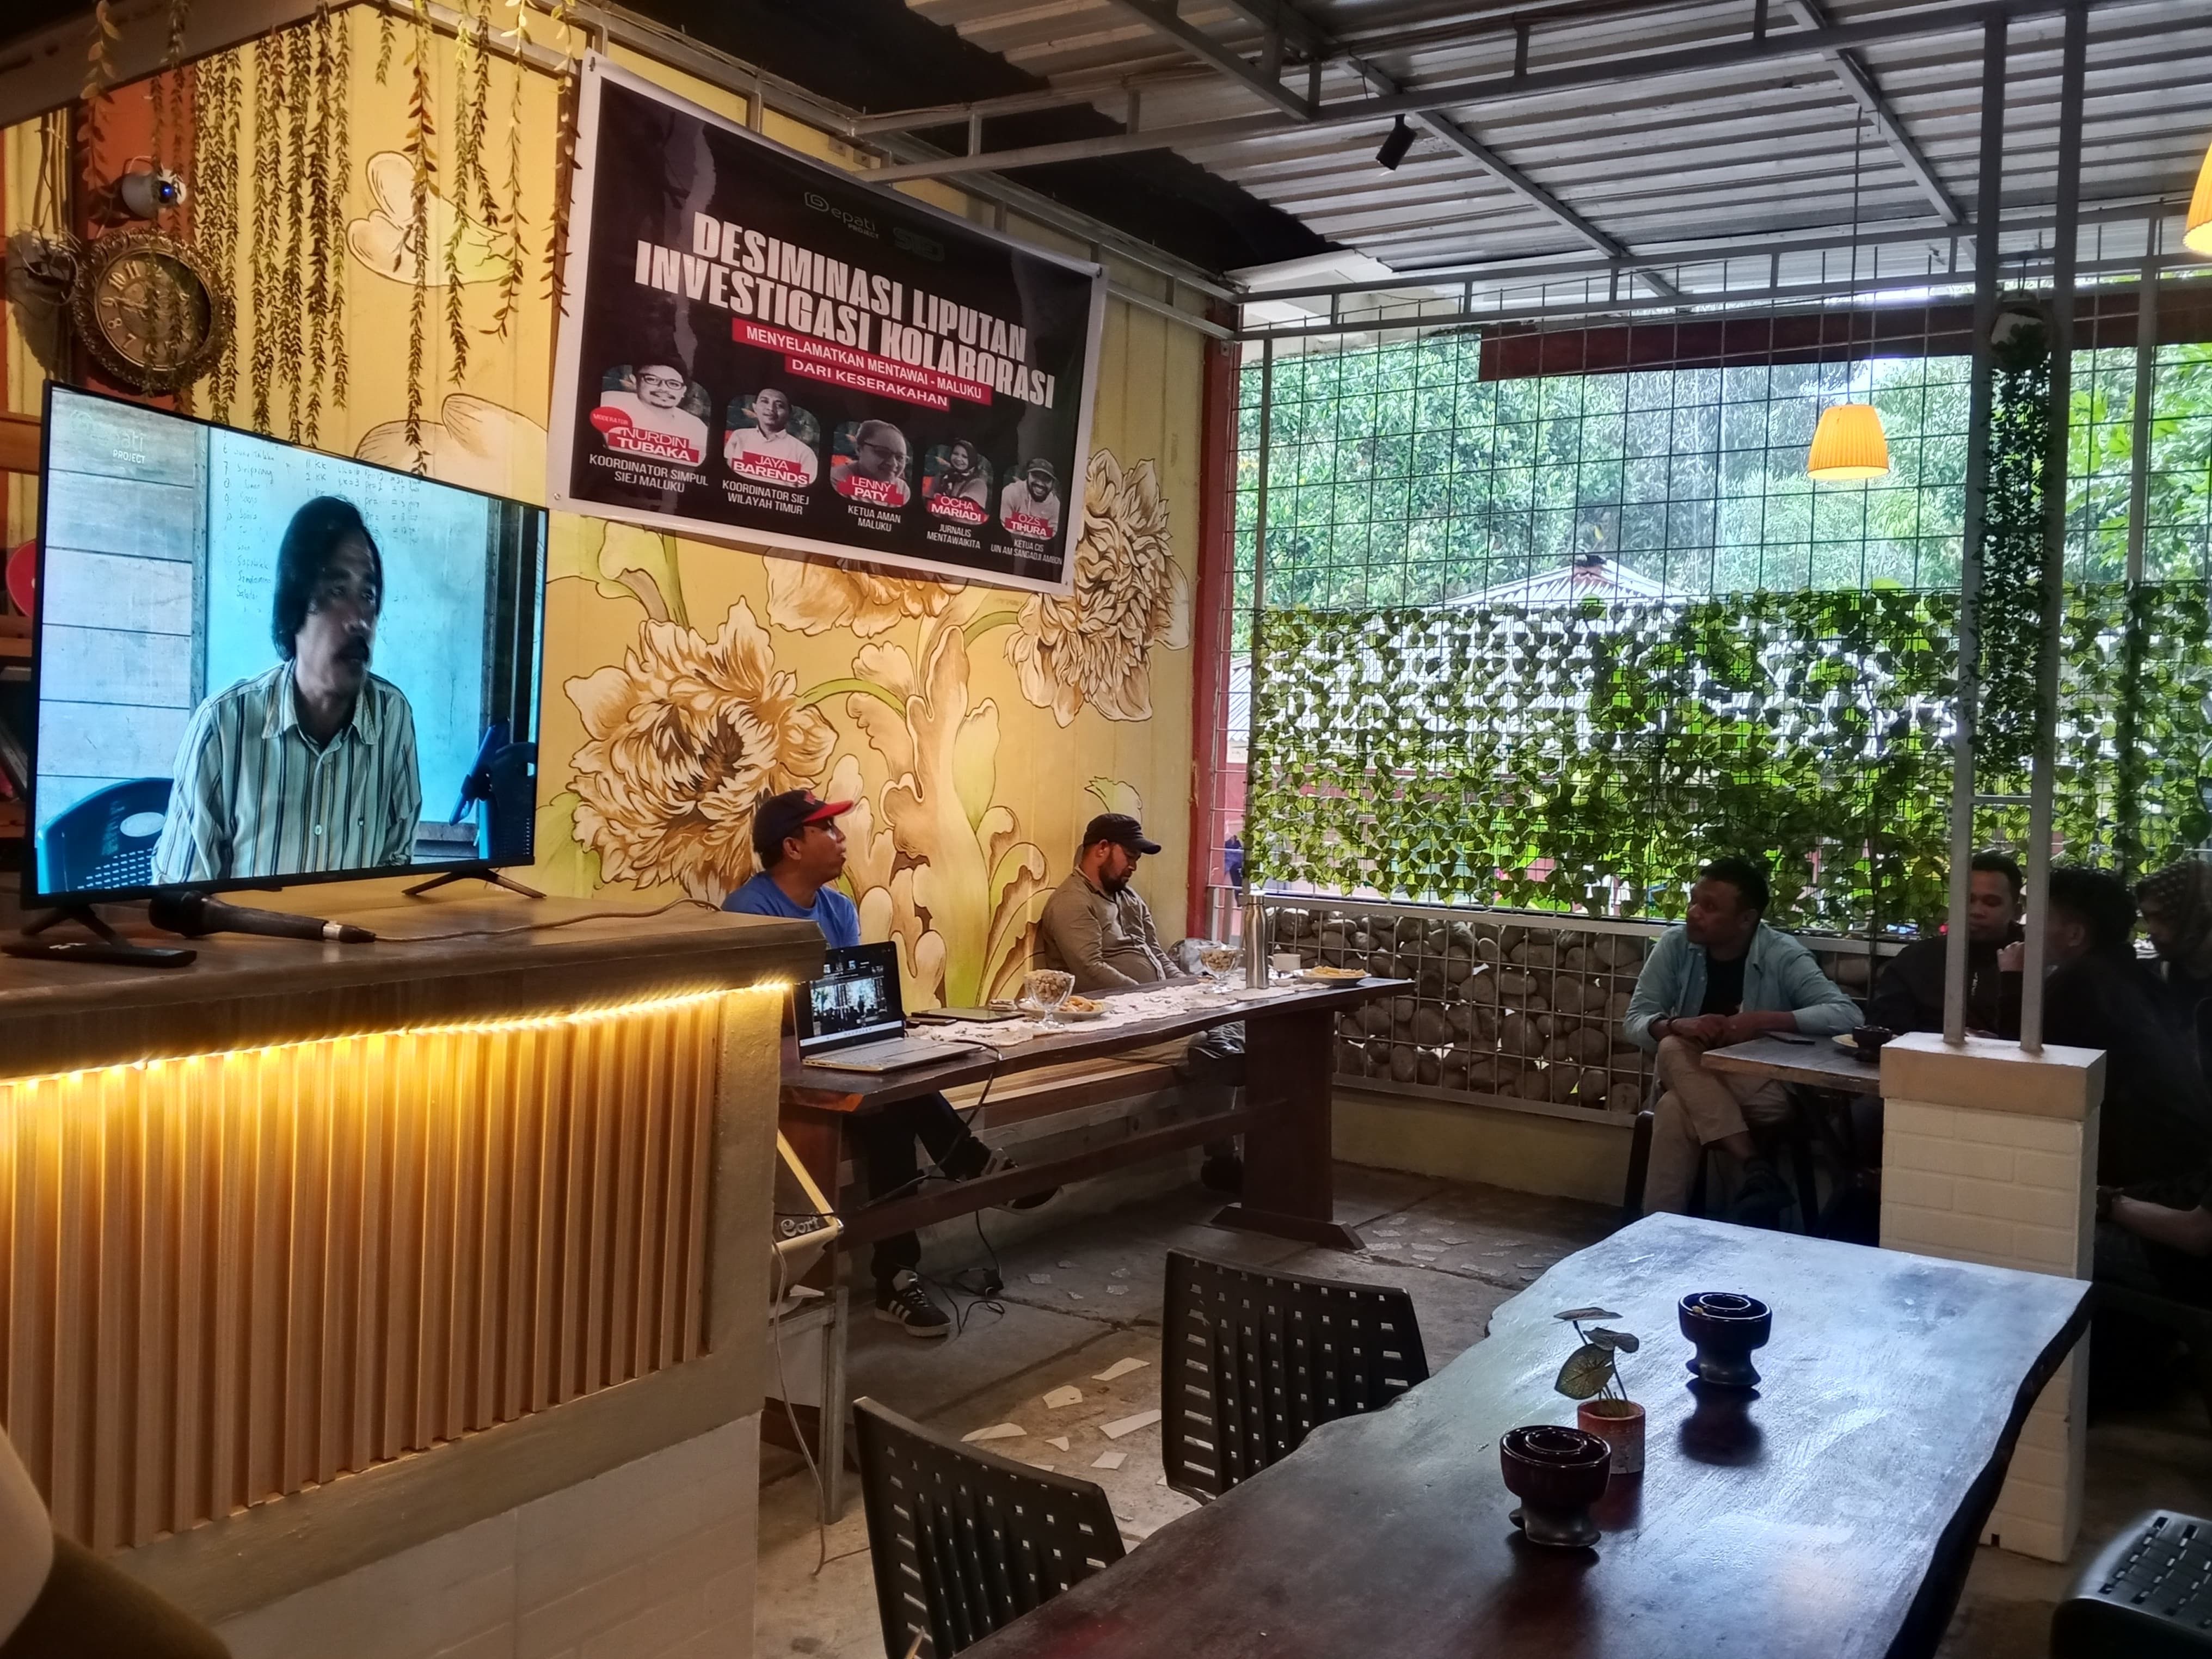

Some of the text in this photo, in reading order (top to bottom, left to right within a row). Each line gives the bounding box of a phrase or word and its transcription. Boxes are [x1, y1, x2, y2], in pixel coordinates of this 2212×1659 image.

[847, 223, 880, 239] PROJECT
[692, 211, 1027, 362] DESIMINASI LIPUTAN
[634, 239, 1055, 409] INVESTIGASI KOLABORASI
[746, 325, 865, 369] MENYELAMATKAN
[867, 358, 928, 385] MENTAWAI
[937, 376, 982, 400] MALUKU
[791, 359, 948, 407] DARI KESERAKAHAN
[593, 413, 628, 425] MODERATOR
[622, 427, 687, 449] NURDIN
[113, 449, 145, 464] PROJECT
[617, 437, 691, 461] TUBAKA
[589, 454, 709, 486] KOORDINATOR SIMPUL
[733, 460, 809, 485] BARENDS
[755, 456, 789, 471] JAYA
[614, 471, 685, 493] SIEJ MALUKU
[851, 476, 892, 492] LENNY
[722, 480, 810, 505] KOORDINATOR SIEJ
[854, 487, 888, 501] PATY
[727, 492, 803, 515] WILAYAH TIMUR
[931, 503, 981, 522] MARIADI
[941, 496, 974, 511] OCHA
[847, 505, 901, 523] KETUA AMAN
[857, 518, 892, 532] MALUKU
[939, 523, 972, 538] JURNALIS
[1011, 520, 1047, 537] TIHURA
[926, 531, 981, 549] MENTAWAIKITA
[1013, 538, 1034, 550] KETUA
[990, 544, 1063, 565] UIN AM SANGADJI AMBON
